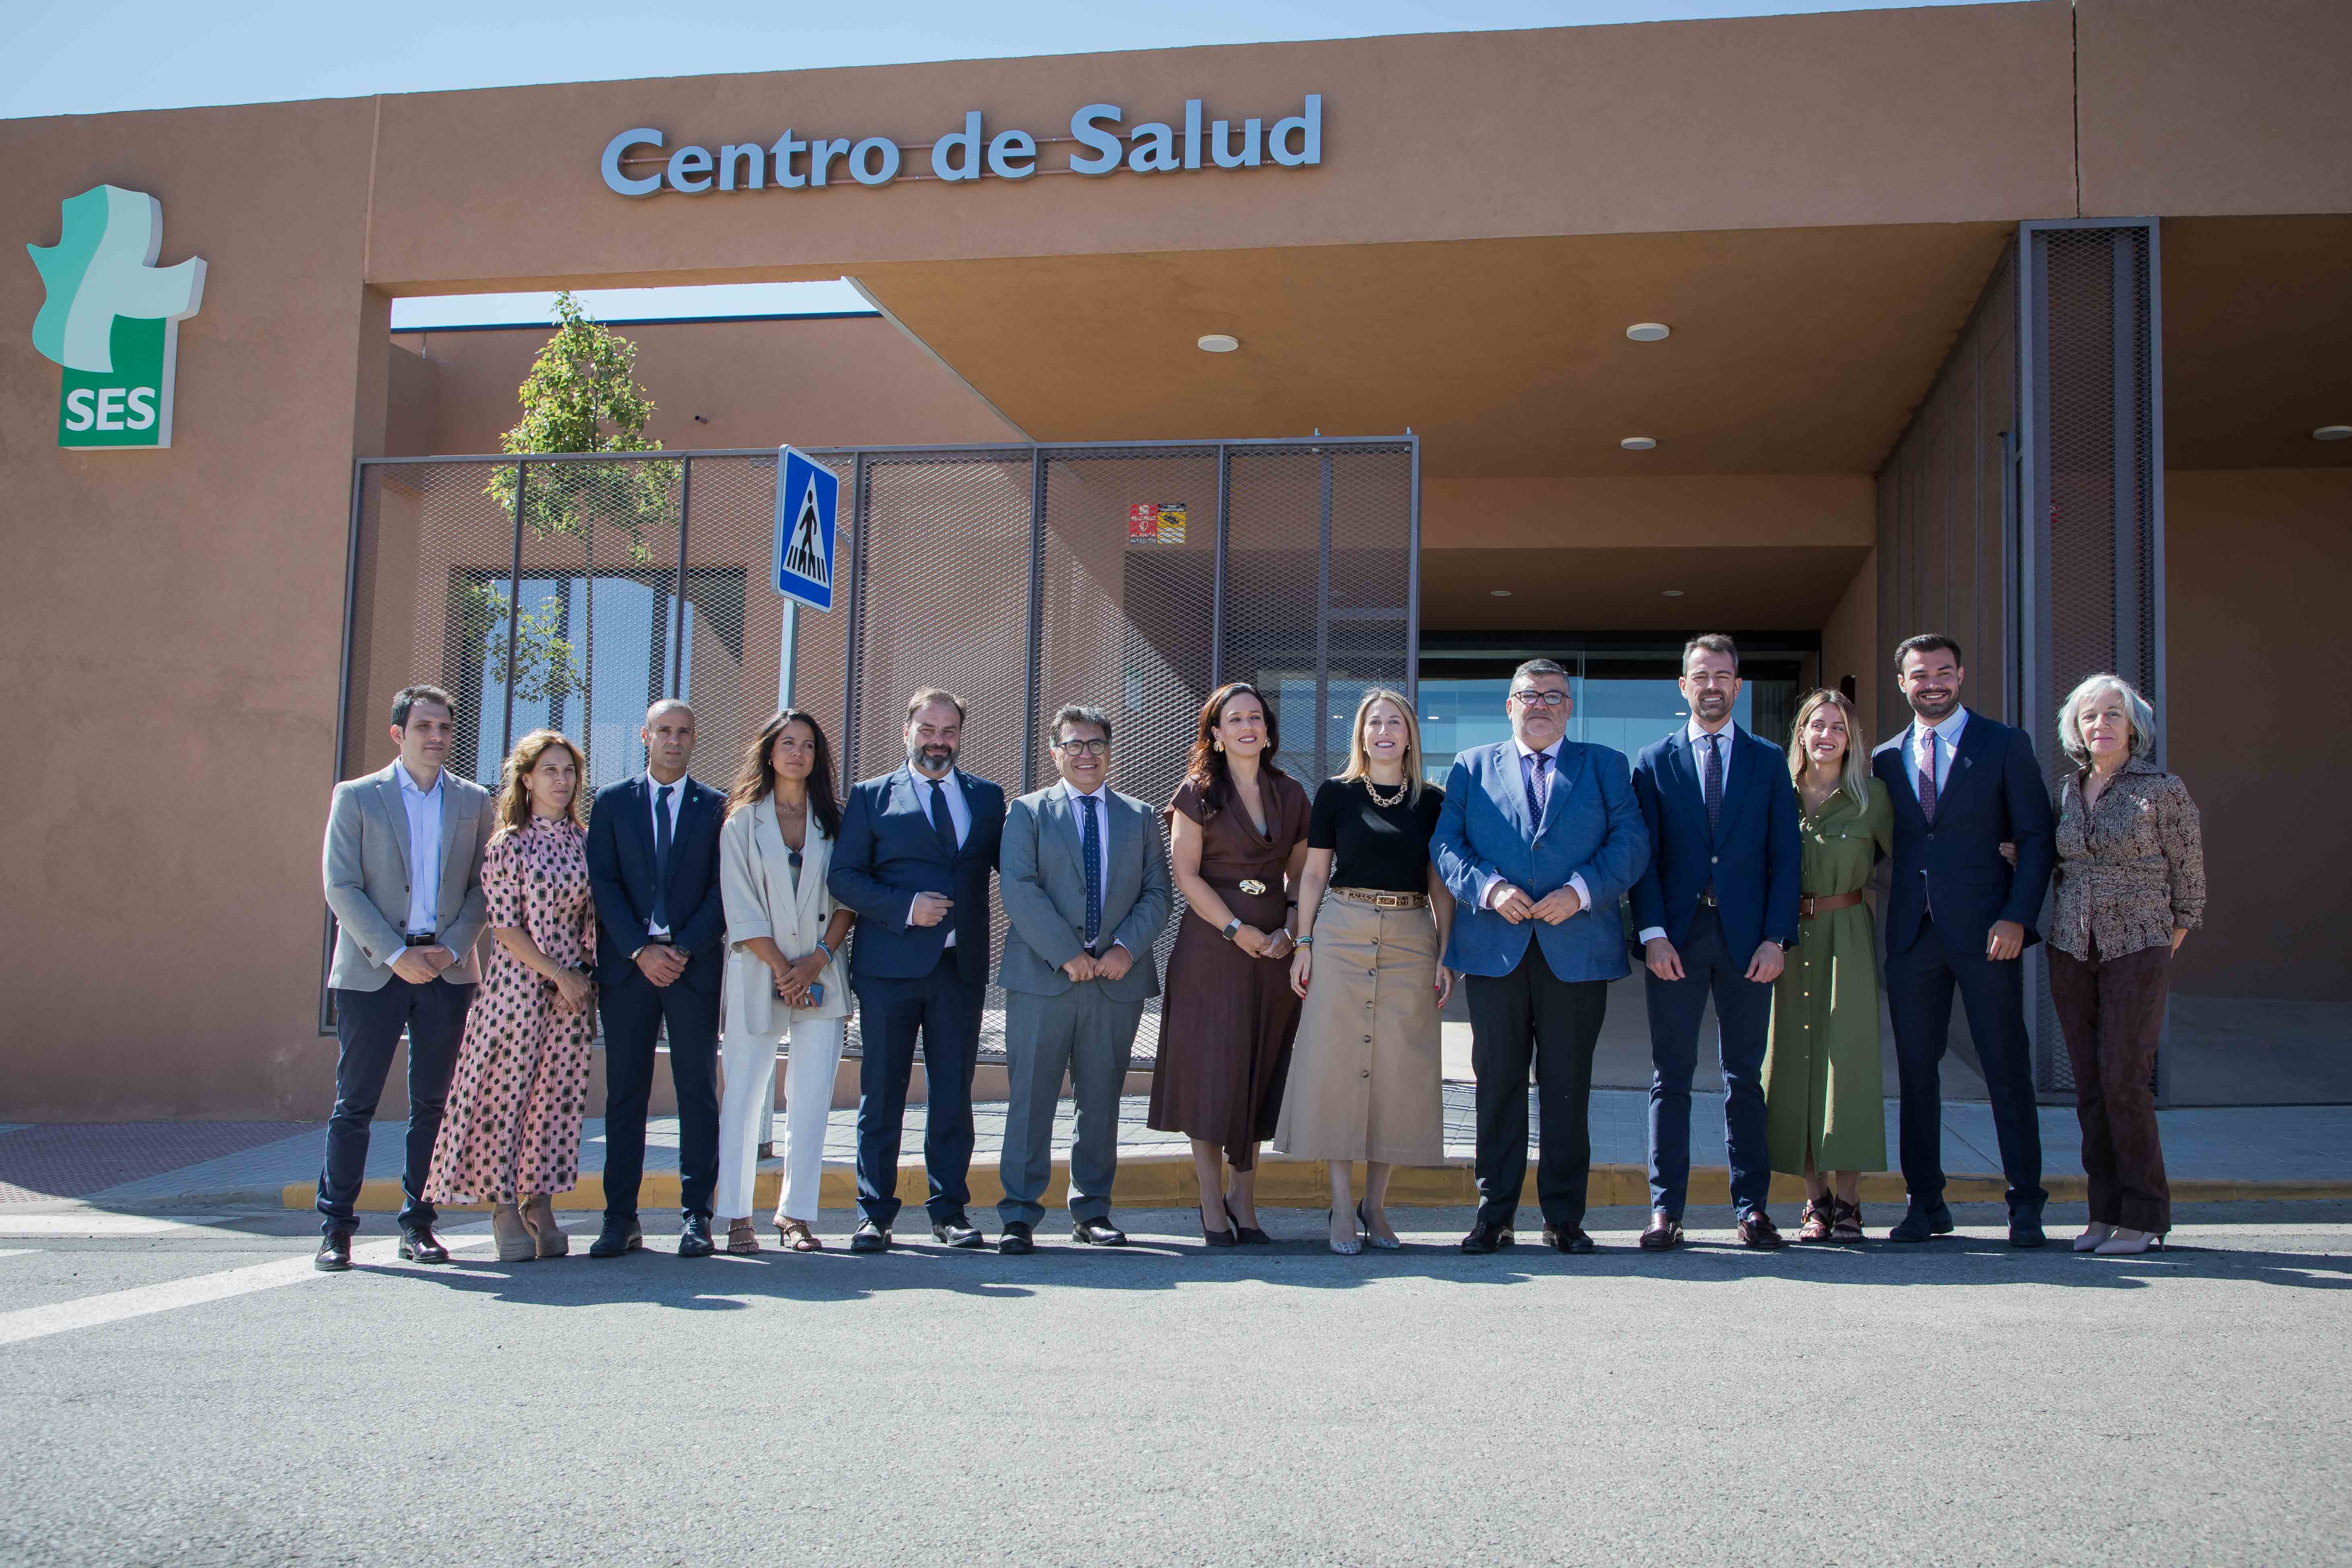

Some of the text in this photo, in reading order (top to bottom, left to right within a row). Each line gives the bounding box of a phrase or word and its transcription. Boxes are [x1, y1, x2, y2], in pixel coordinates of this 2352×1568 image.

[601, 94, 1322, 196] Centro de Salud
[66, 387, 155, 431] SES
